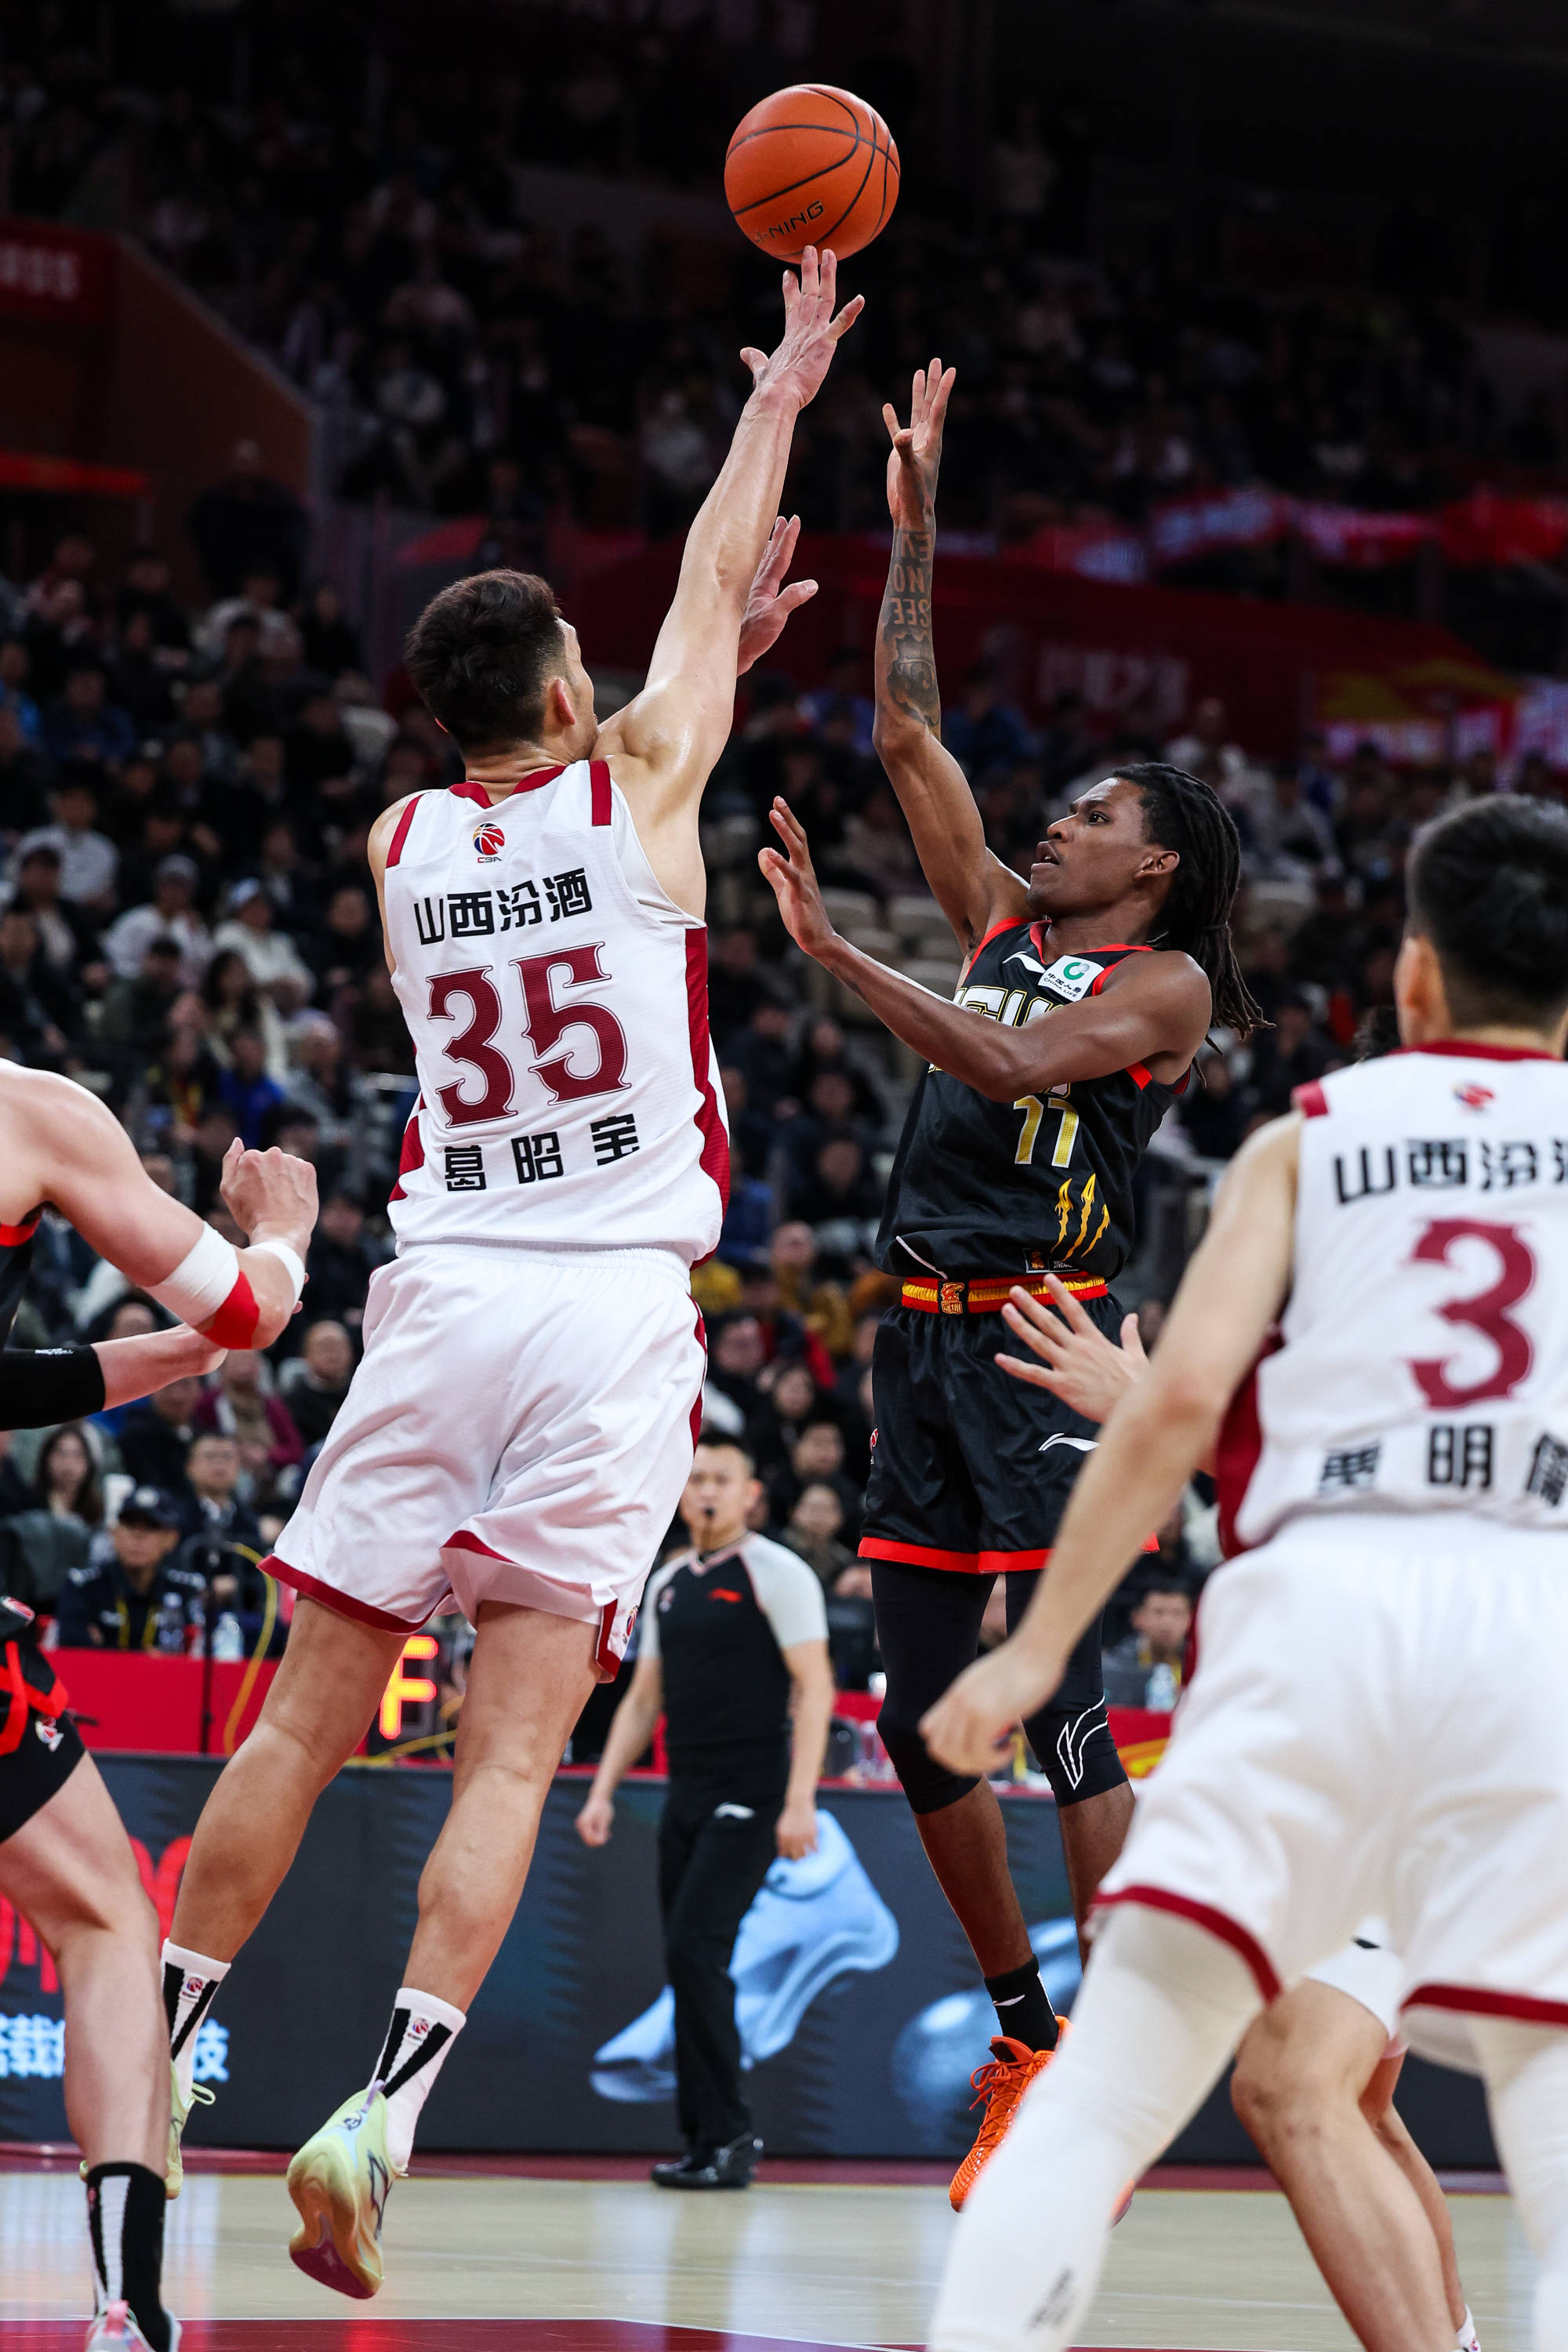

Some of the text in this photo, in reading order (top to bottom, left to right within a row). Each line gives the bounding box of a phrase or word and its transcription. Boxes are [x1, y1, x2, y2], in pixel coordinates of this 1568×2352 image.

[894, 564, 924, 593] NO
[891, 597, 929, 628] SEE
[414, 868, 593, 946] 山西汾酒
[1044, 977, 1077, 998] CHINA LIFE
[1047, 973, 1082, 994] 中国人寿
[426, 941, 632, 1128] 35
[1405, 1218, 1536, 1411] 3
[379, 1635, 439, 1740] F
